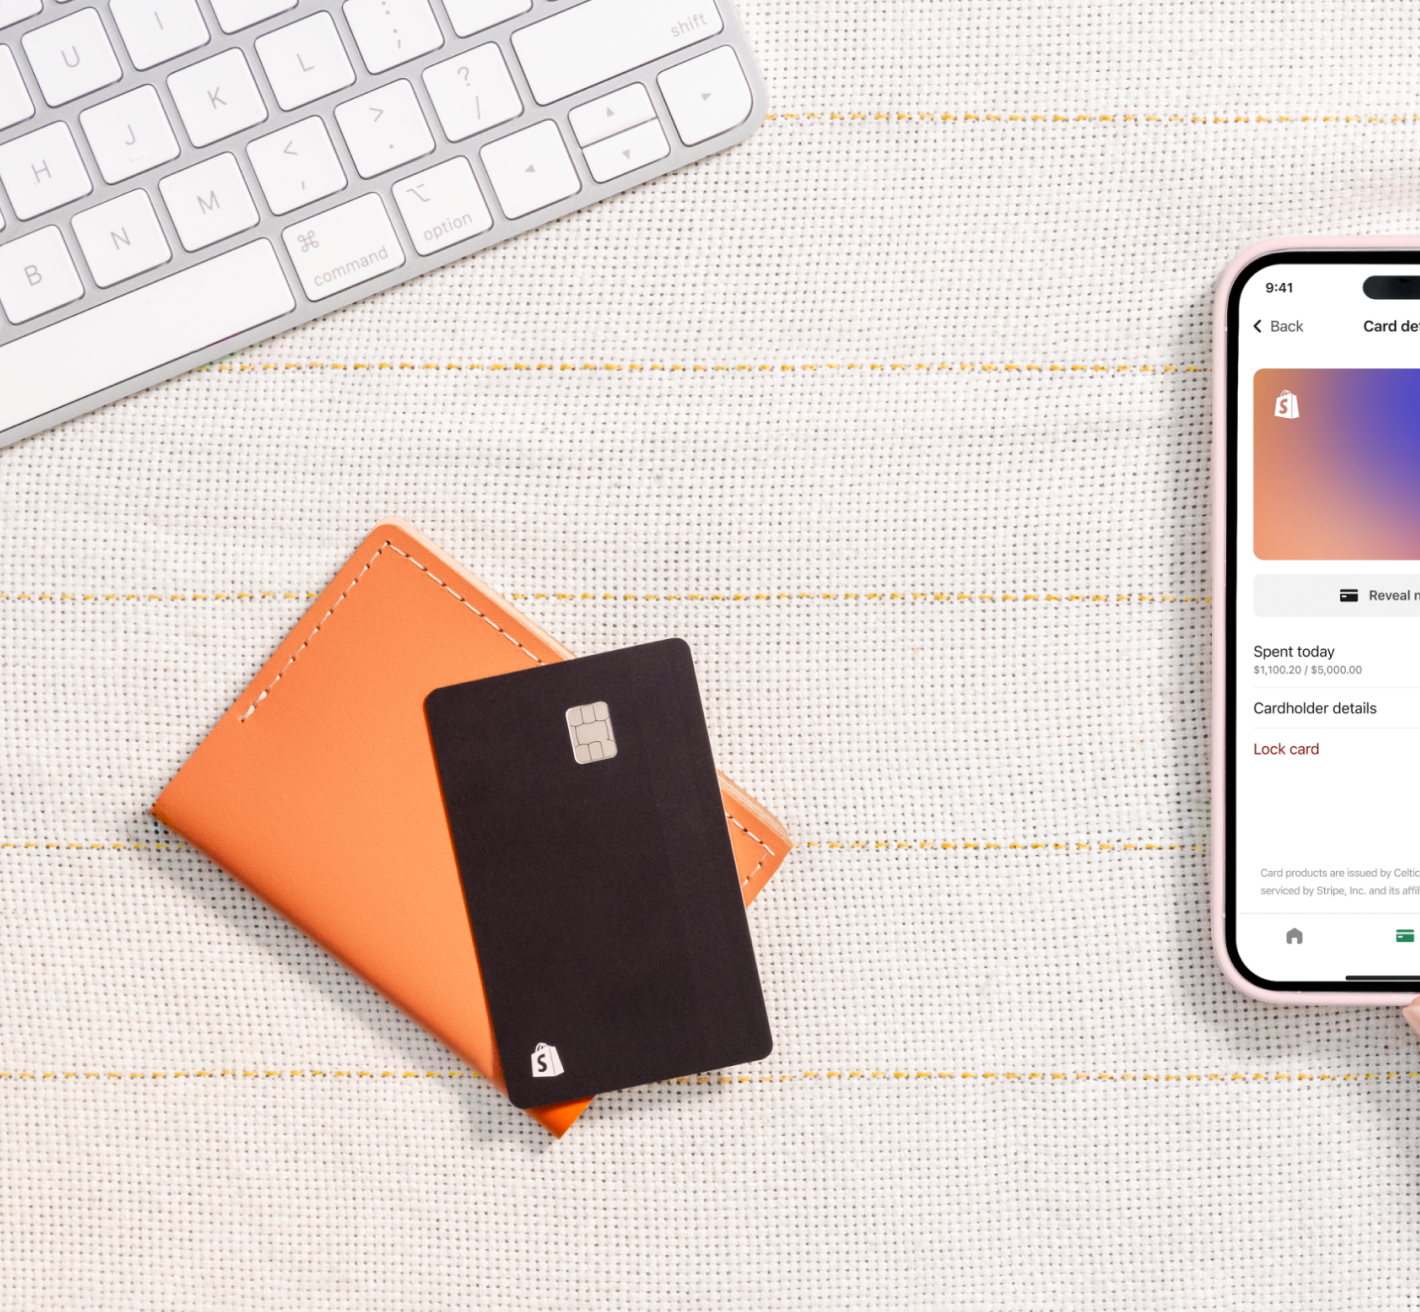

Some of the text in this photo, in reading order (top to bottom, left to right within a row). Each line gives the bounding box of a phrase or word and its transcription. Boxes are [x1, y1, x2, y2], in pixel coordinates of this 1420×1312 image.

[670, 13, 709, 38] shift
[60, 45, 81, 68] U
[296, 53, 315, 73] L
[206, 86, 228, 110] K
[125, 123, 136, 146] J
[30, 159, 52, 183] H
[196, 189, 221, 215] M
[423, 213, 473, 241] option
[109, 226, 132, 251] N
[23, 264, 43, 287] B
[314, 245, 389, 287] command
[1265, 281, 1293, 294] 9:41
[1270, 319, 1304, 333] Back
[1362, 319, 1398, 333] Card
[1368, 589, 1411, 602] Reveal
[1253, 644, 1336, 661] Spent today
[1253, 664, 1363, 677] $1,100.20 / $5,000.00
[1253, 701, 1378, 715] Cardholder details
[1253, 742, 1320, 756] Lock card
[1260, 867, 1284, 878] Card
[1285, 868, 1328, 880] products
[1329, 870, 1346, 878] are
[1346, 867, 1378, 878] issued
[1379, 868, 1392, 880] by
[1393, 867, 1420, 878] Celtic
[1260, 885, 1301, 896] serviced
[1302, 885, 1315, 897] by
[1316, 885, 1347, 897] Stripe,
[1349, 886, 1367, 896] Inc.
[1368, 885, 1387, 896] and
[1388, 885, 1401, 896] its
